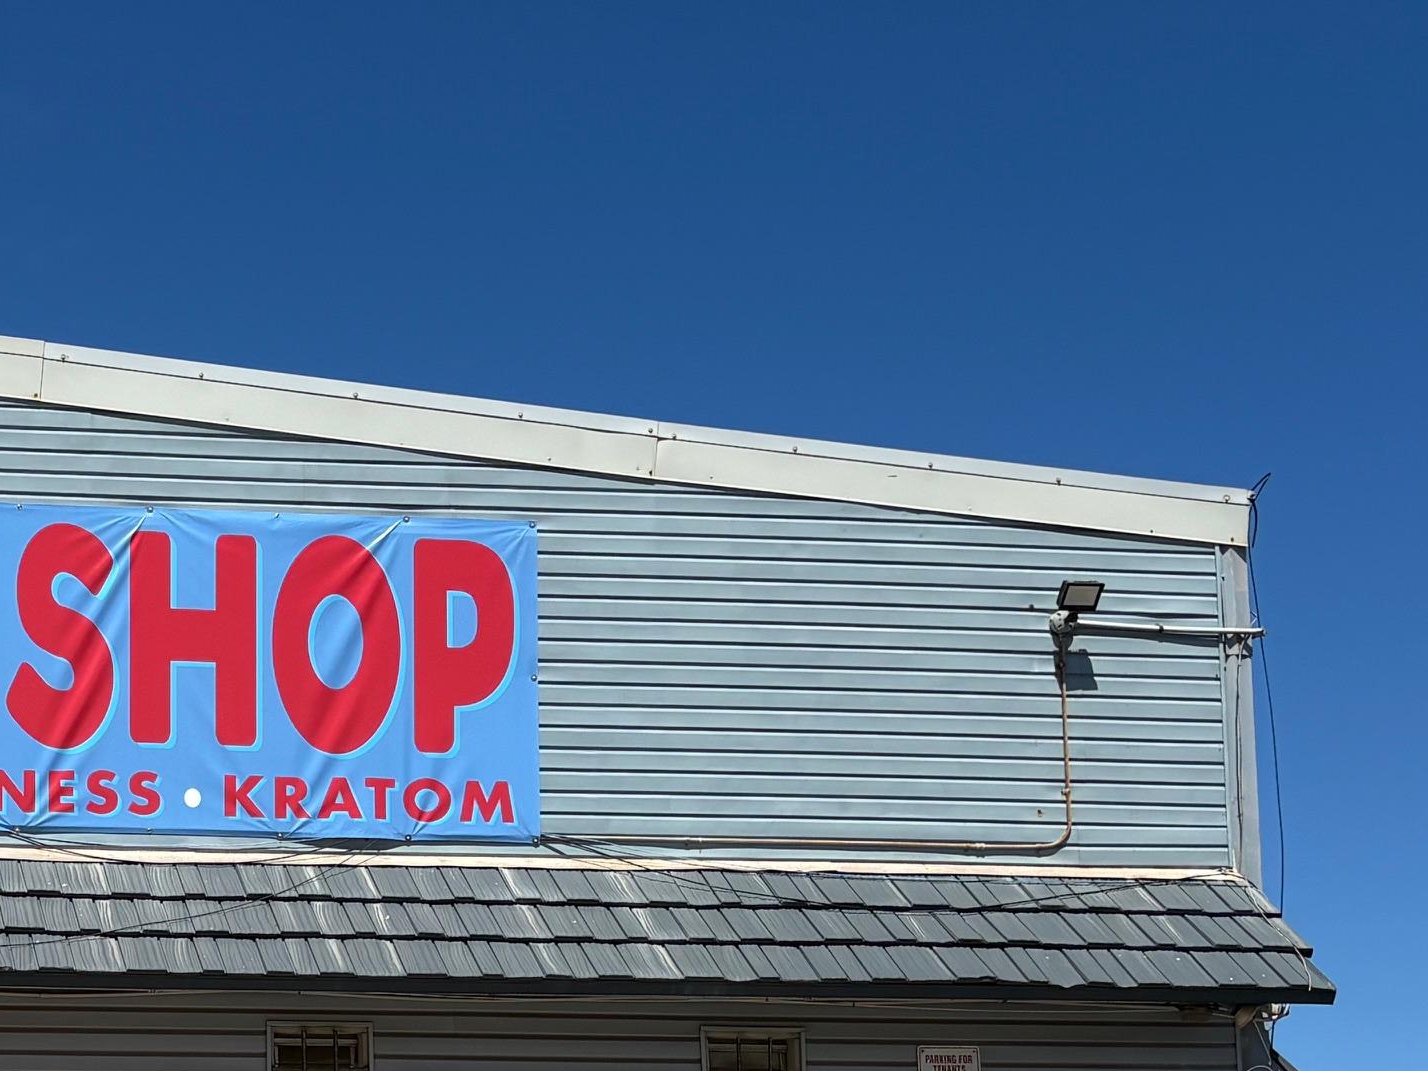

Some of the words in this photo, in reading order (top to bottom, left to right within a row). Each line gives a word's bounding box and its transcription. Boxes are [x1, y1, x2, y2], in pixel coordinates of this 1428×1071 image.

[6, 523, 516, 754] SHOP
[224, 775, 514, 823] KRATOM
[925, 1055, 957, 1064] PARKING
[958, 1055, 973, 1064] FOR
